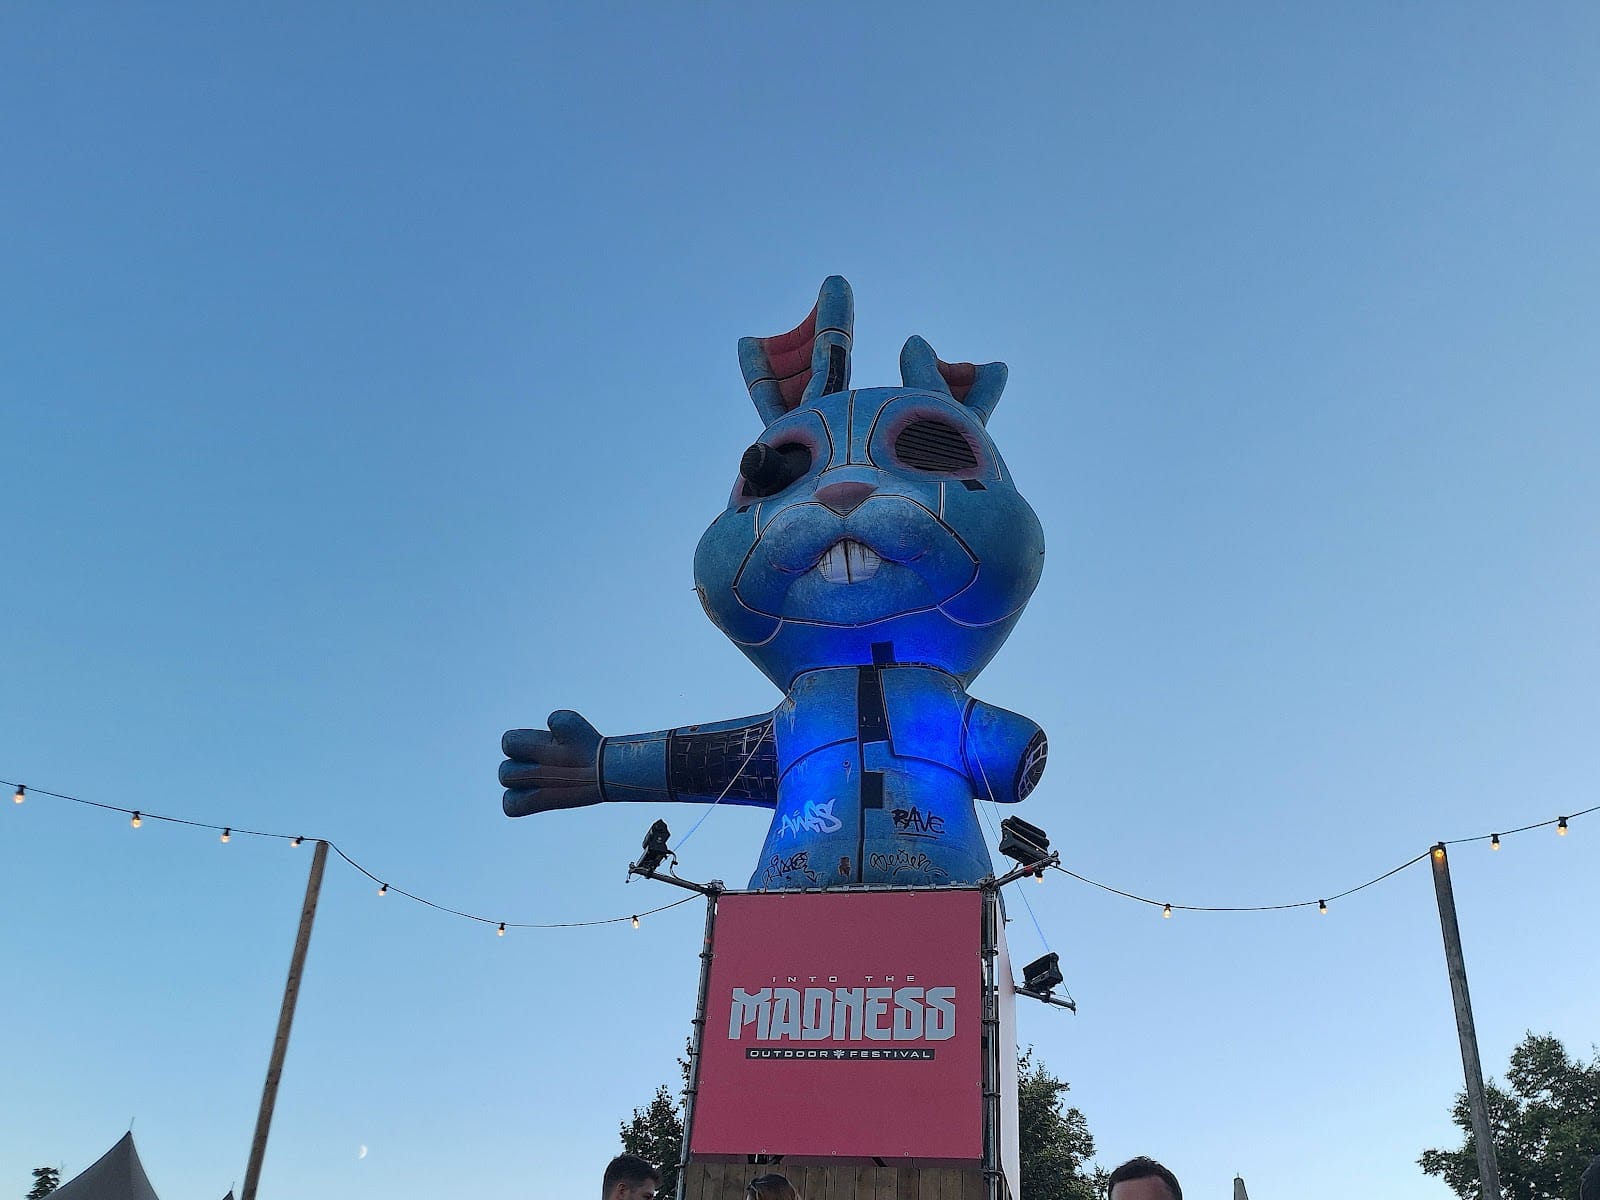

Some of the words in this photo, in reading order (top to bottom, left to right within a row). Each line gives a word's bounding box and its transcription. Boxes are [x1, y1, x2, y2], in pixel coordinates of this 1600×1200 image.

[892, 807, 945, 834] RAVE
[728, 987, 956, 1041] MADNESS
[749, 1050, 828, 1058] OUTDOOR
[849, 1050, 930, 1058] FESTIVAL
